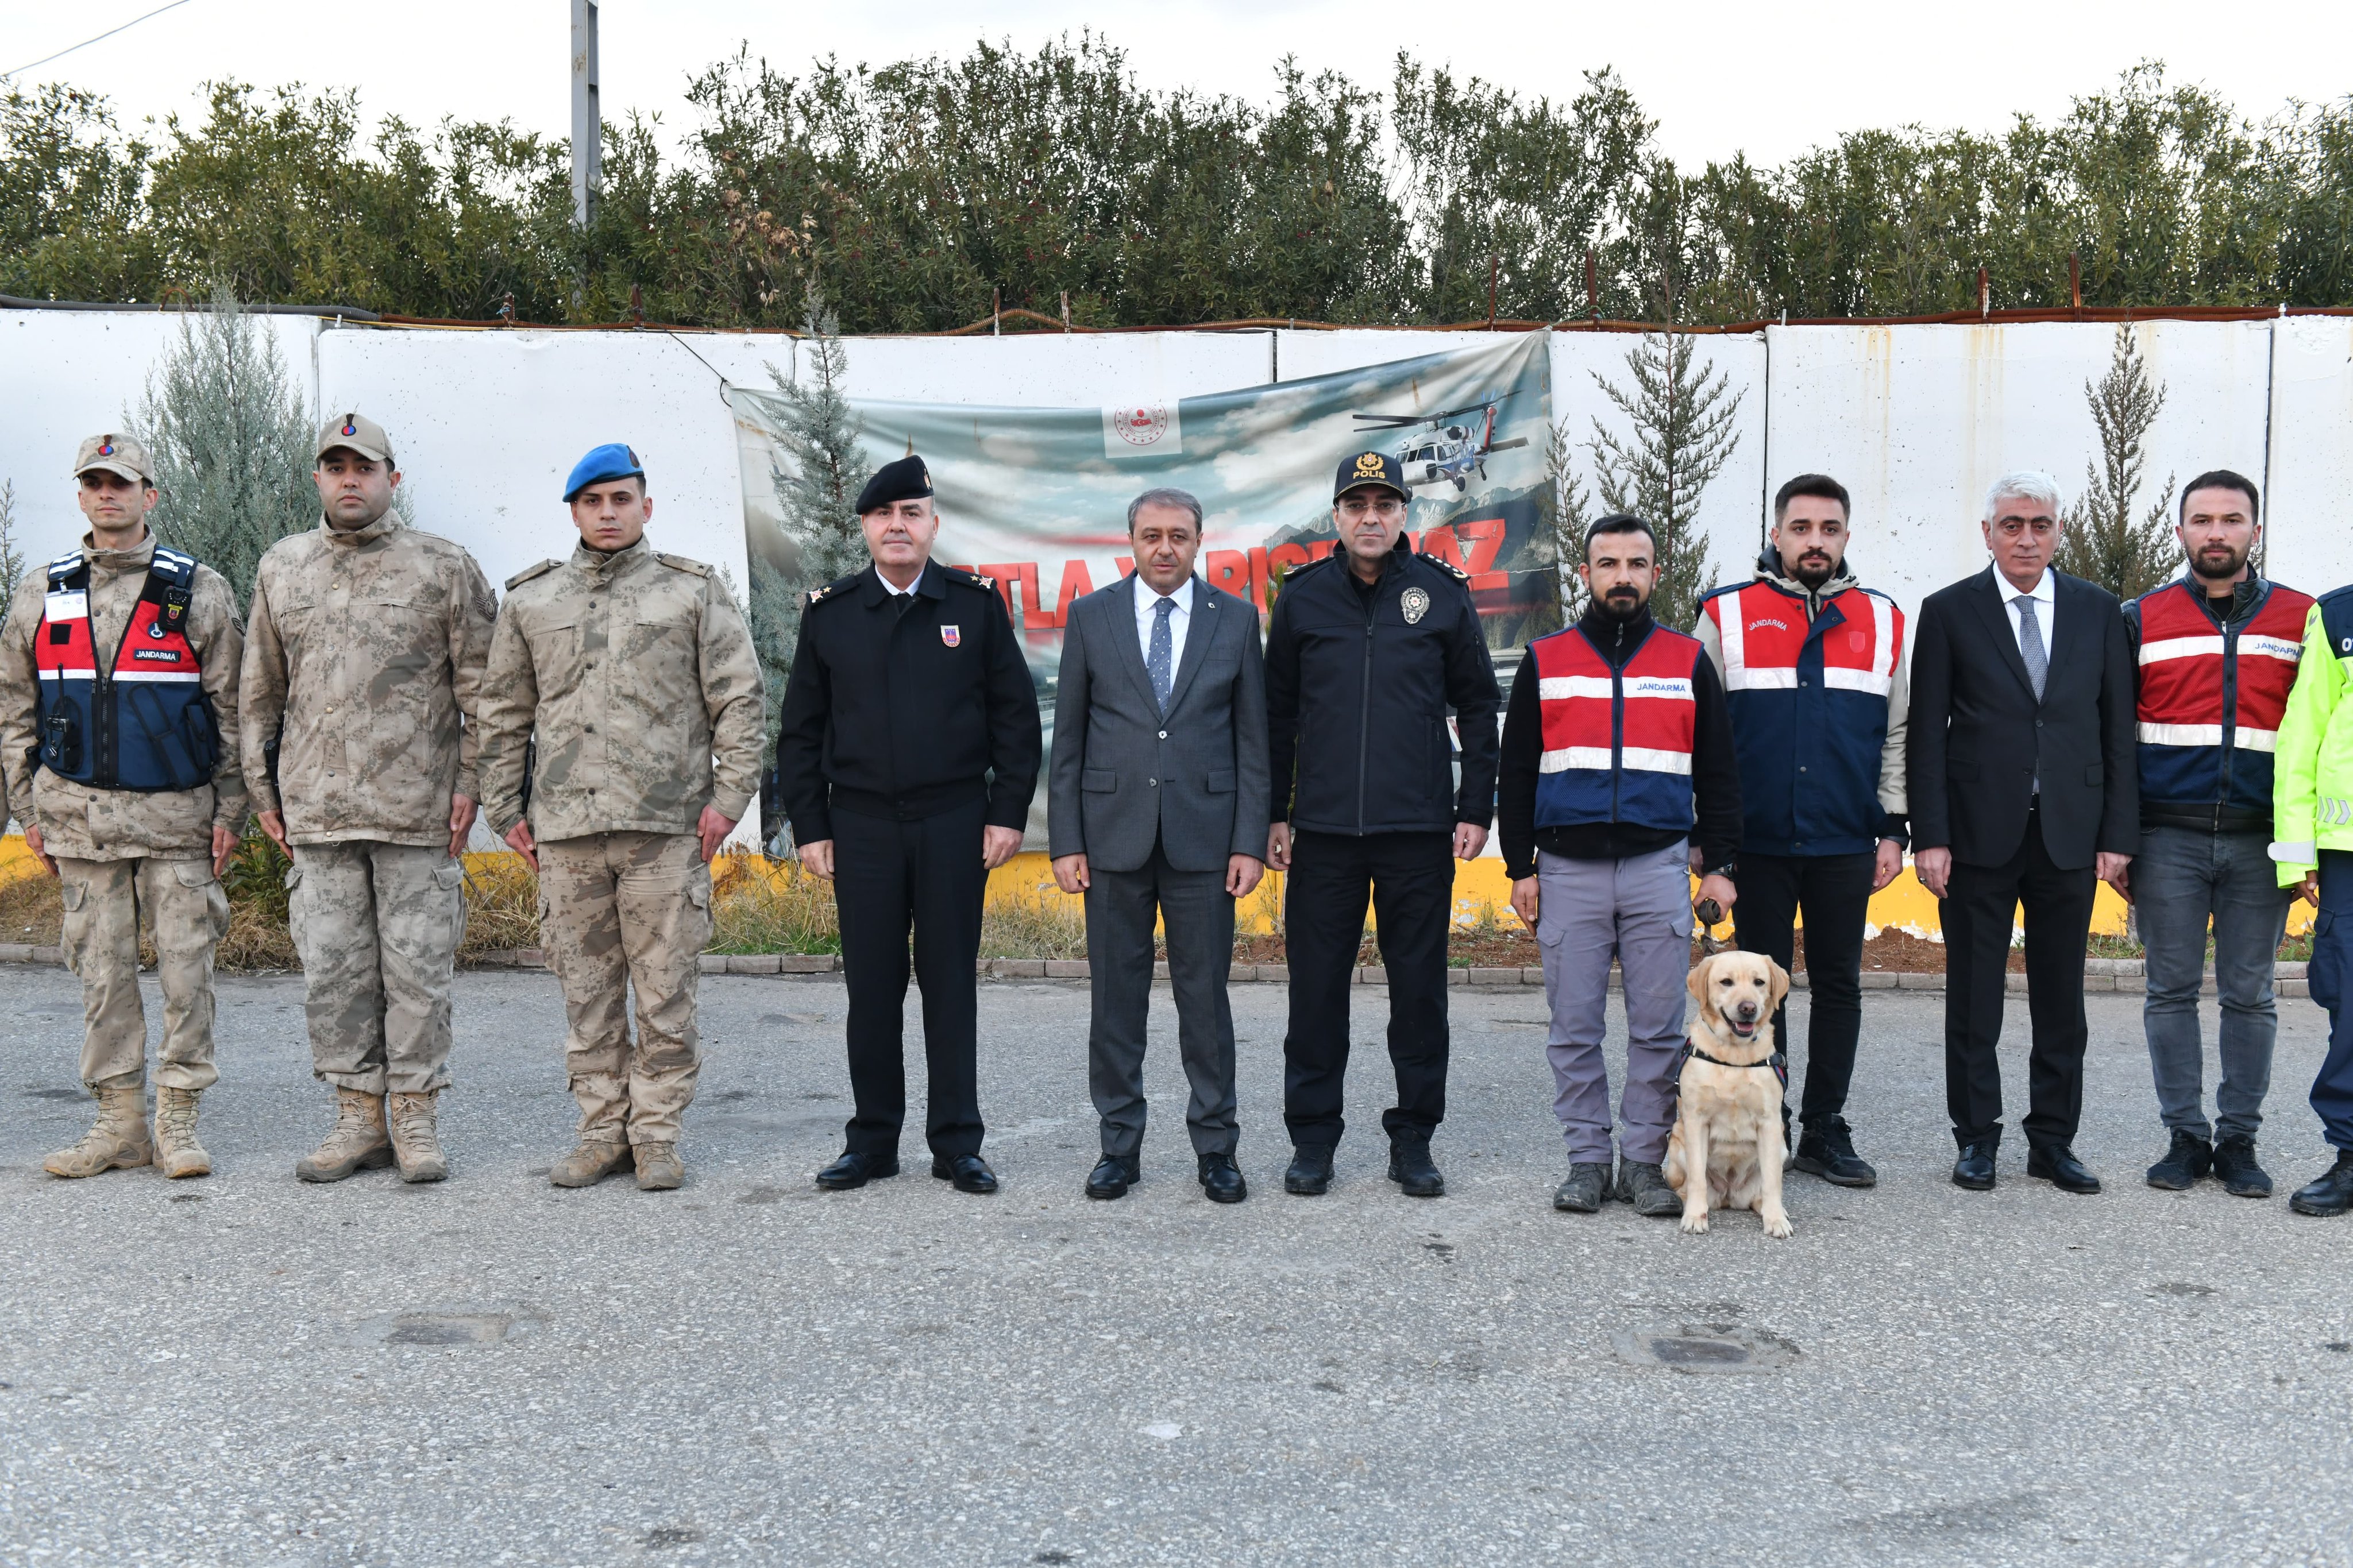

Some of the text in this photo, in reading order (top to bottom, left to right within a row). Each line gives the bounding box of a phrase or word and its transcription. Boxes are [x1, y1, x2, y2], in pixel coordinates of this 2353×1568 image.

[1749, 619, 1787, 631] JANDARMA
[136, 650, 176, 661] JANDARMA
[1637, 683, 1686, 692] JANDARMA
